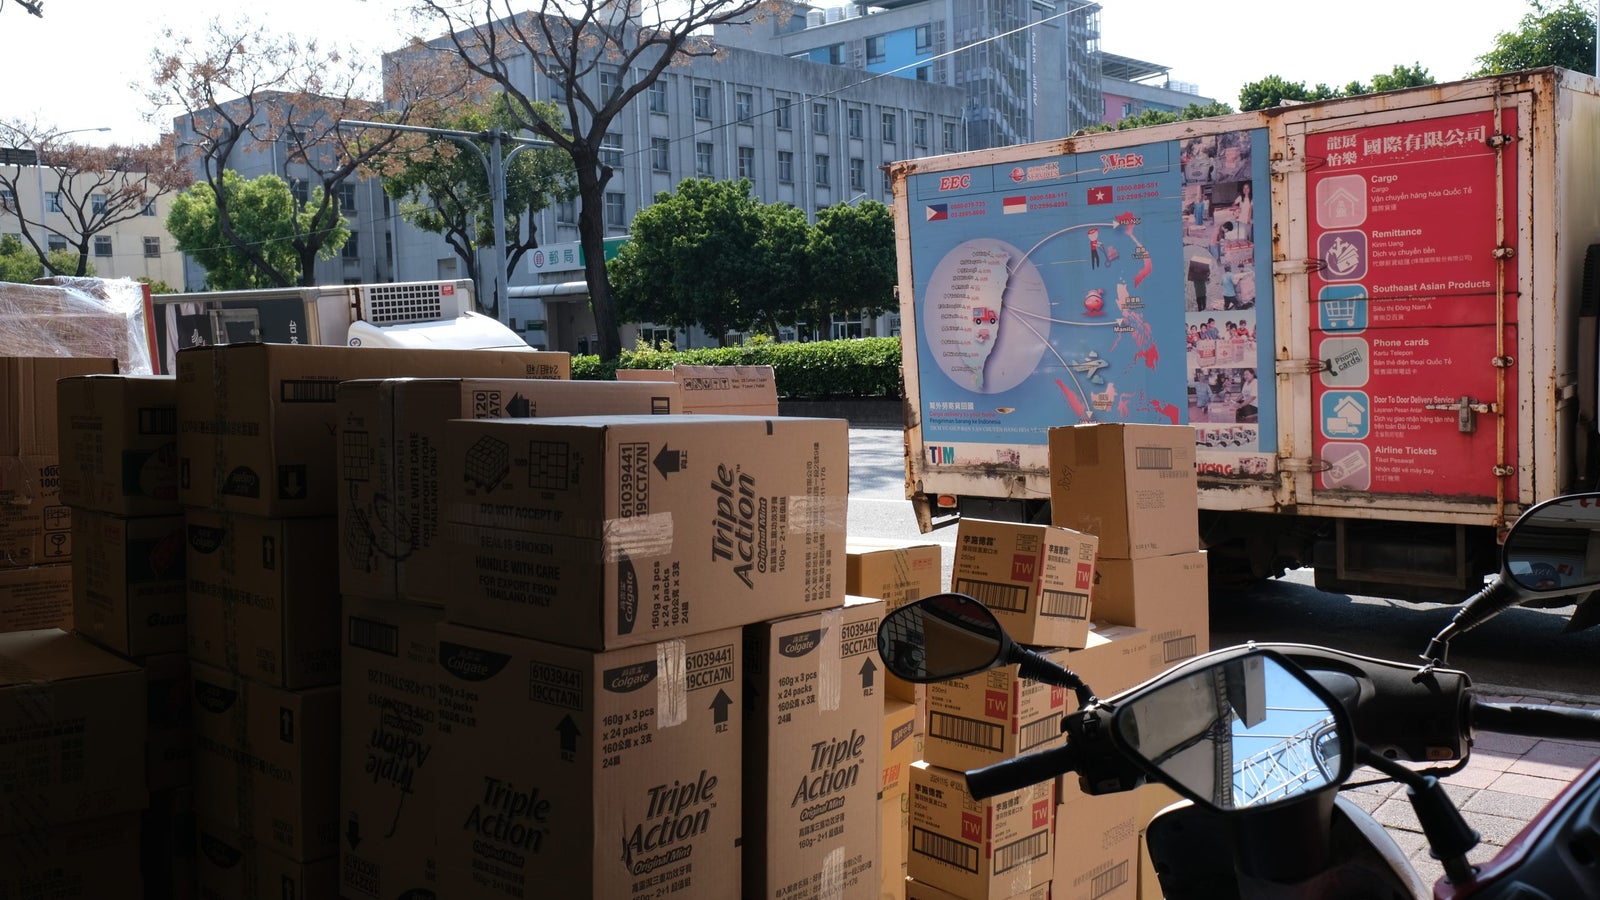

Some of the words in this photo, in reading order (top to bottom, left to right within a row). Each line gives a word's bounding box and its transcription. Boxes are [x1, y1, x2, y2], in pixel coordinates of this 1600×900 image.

[1363, 124, 1487, 157] 國際有限公司
[938, 173, 971, 192] EEC
[1371, 173, 1399, 184] Cargo
[1371, 185, 1390, 194] Cargo
[1372, 227, 1423, 238] Remittance
[549, 249, 574, 266] 郵局
[1372, 283, 1418, 294] Southeast
[1419, 281, 1446, 292] Asian
[1447, 279, 1491, 290] Products
[1113, 326, 1135, 334] Manila
[1373, 338, 1401, 347] Phone
[1404, 337, 1430, 347] cards
[1335, 349, 1358, 366] Phone
[1338, 355, 1361, 373] cards
[1390, 349, 1414, 358] Telepon
[1374, 395, 1388, 404] Door
[1388, 395, 1396, 404] To
[1396, 395, 1410, 404] Door
[1410, 395, 1433, 405] Delivery
[1434, 395, 1455, 404] Service
[410, 431, 420, 465] CARE
[422, 436, 431, 471] FROM
[1374, 446, 1403, 455] Airline
[1405, 446, 1437, 456] Tickets
[430, 446, 438, 478] ONLY
[410, 466, 420, 499] WITH
[621, 446, 633, 519] 61039441
[636, 446, 648, 518] 19CCTA7N
[422, 474, 431, 523] EXPORT
[431, 478, 439, 538] THAILAND
[481, 502, 492, 514] DO
[495, 503, 514, 517] NOT
[515, 506, 551, 521] ACCEPT
[553, 510, 564, 522] IF
[711, 463, 738, 563] Triple
[758, 496, 768, 526] Mint
[410, 501, 420, 551] HANDLE
[733, 472, 756, 590] Action
[480, 535, 502, 548] SEAL
[515, 540, 554, 555] BROKEN
[758, 527, 768, 574] Original
[475, 556, 510, 573] HANDLE
[511, 560, 534, 576] WITH
[536, 564, 561, 580] CARE
[654, 561, 662, 582] pcs
[1015, 562, 1033, 575] TW
[1078, 571, 1090, 583] TW
[479, 575, 495, 586] FOR
[497, 577, 531, 592] EXPORT
[533, 582, 558, 596] FROM
[661, 568, 671, 603] packs
[486, 587, 526, 604] THAILAND
[528, 594, 551, 608] ONLY
[624, 571, 634, 623] Colgate
[651, 604, 662, 630] 160g
[662, 605, 670, 619] 24
[841, 623, 878, 641] 61039441
[785, 639, 814, 654] Colgate
[841, 637, 878, 658] 19CCTA7N
[447, 656, 489, 676] Colgate
[686, 648, 732, 671] 61039441
[532, 664, 581, 689] 61039441
[611, 673, 650, 688] Colgate
[686, 668, 732, 690] 19CCTA7N
[778, 675, 794, 688] 160g
[800, 673, 805, 682] 3
[805, 671, 817, 683] pcs
[532, 684, 581, 709] 19CCTA7N
[783, 688, 792, 698] 24
[792, 684, 813, 698] packs
[932, 686, 947, 694] 250ml
[1052, 688, 1063, 700] TW
[987, 698, 1007, 711] TW
[602, 713, 623, 728] 160g
[632, 710, 638, 721] 3
[639, 707, 654, 722] pcs
[609, 728, 621, 740] 24
[622, 721, 648, 738] packs
[810, 728, 865, 773] Triple
[791, 761, 859, 808] Action
[484, 775, 551, 824] Triple
[646, 769, 718, 822] Triple
[800, 802, 829, 822] Original
[827, 795, 846, 813] Mint
[914, 803, 928, 811] 250ml
[1034, 807, 1048, 819] TW
[463, 803, 543, 856] Action
[627, 804, 710, 856] Action
[964, 820, 980, 835] TW
[633, 853, 672, 876] Original
[671, 843, 693, 864] Mint
[656, 884, 670, 898] 2+1
